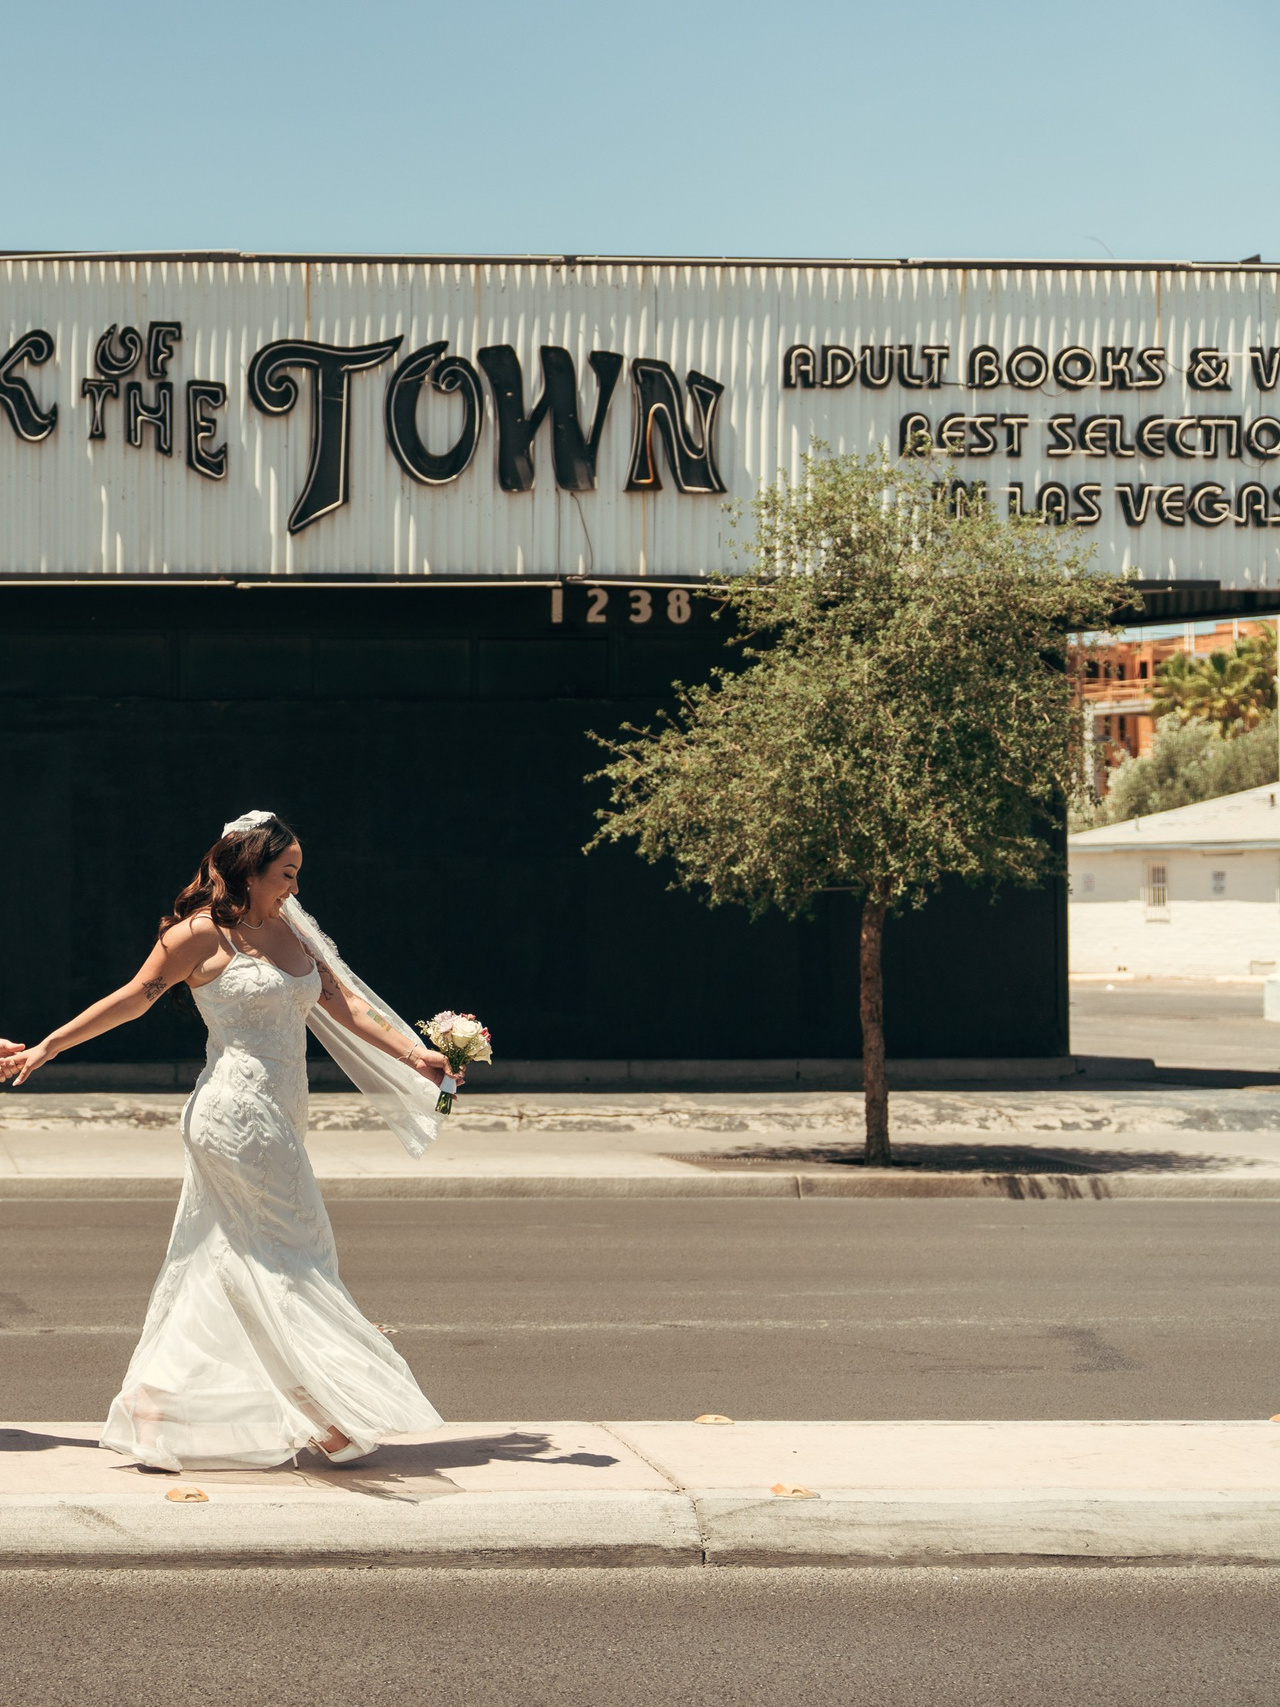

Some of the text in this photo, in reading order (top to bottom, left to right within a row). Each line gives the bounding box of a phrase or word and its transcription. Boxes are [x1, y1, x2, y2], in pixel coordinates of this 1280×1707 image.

[95, 321, 182, 379] OF
[783, 344, 950, 389] ADULT
[967, 344, 1166, 391] BOOKS
[1187, 346, 1232, 391] &
[82, 377, 227, 481] THE
[248, 334, 728, 536] TOWN
[899, 412, 1029, 458] BEST
[1009, 481, 1101, 526] LAS
[1117, 481, 1280, 527] VEGA
[550, 588, 692, 624] 1238
